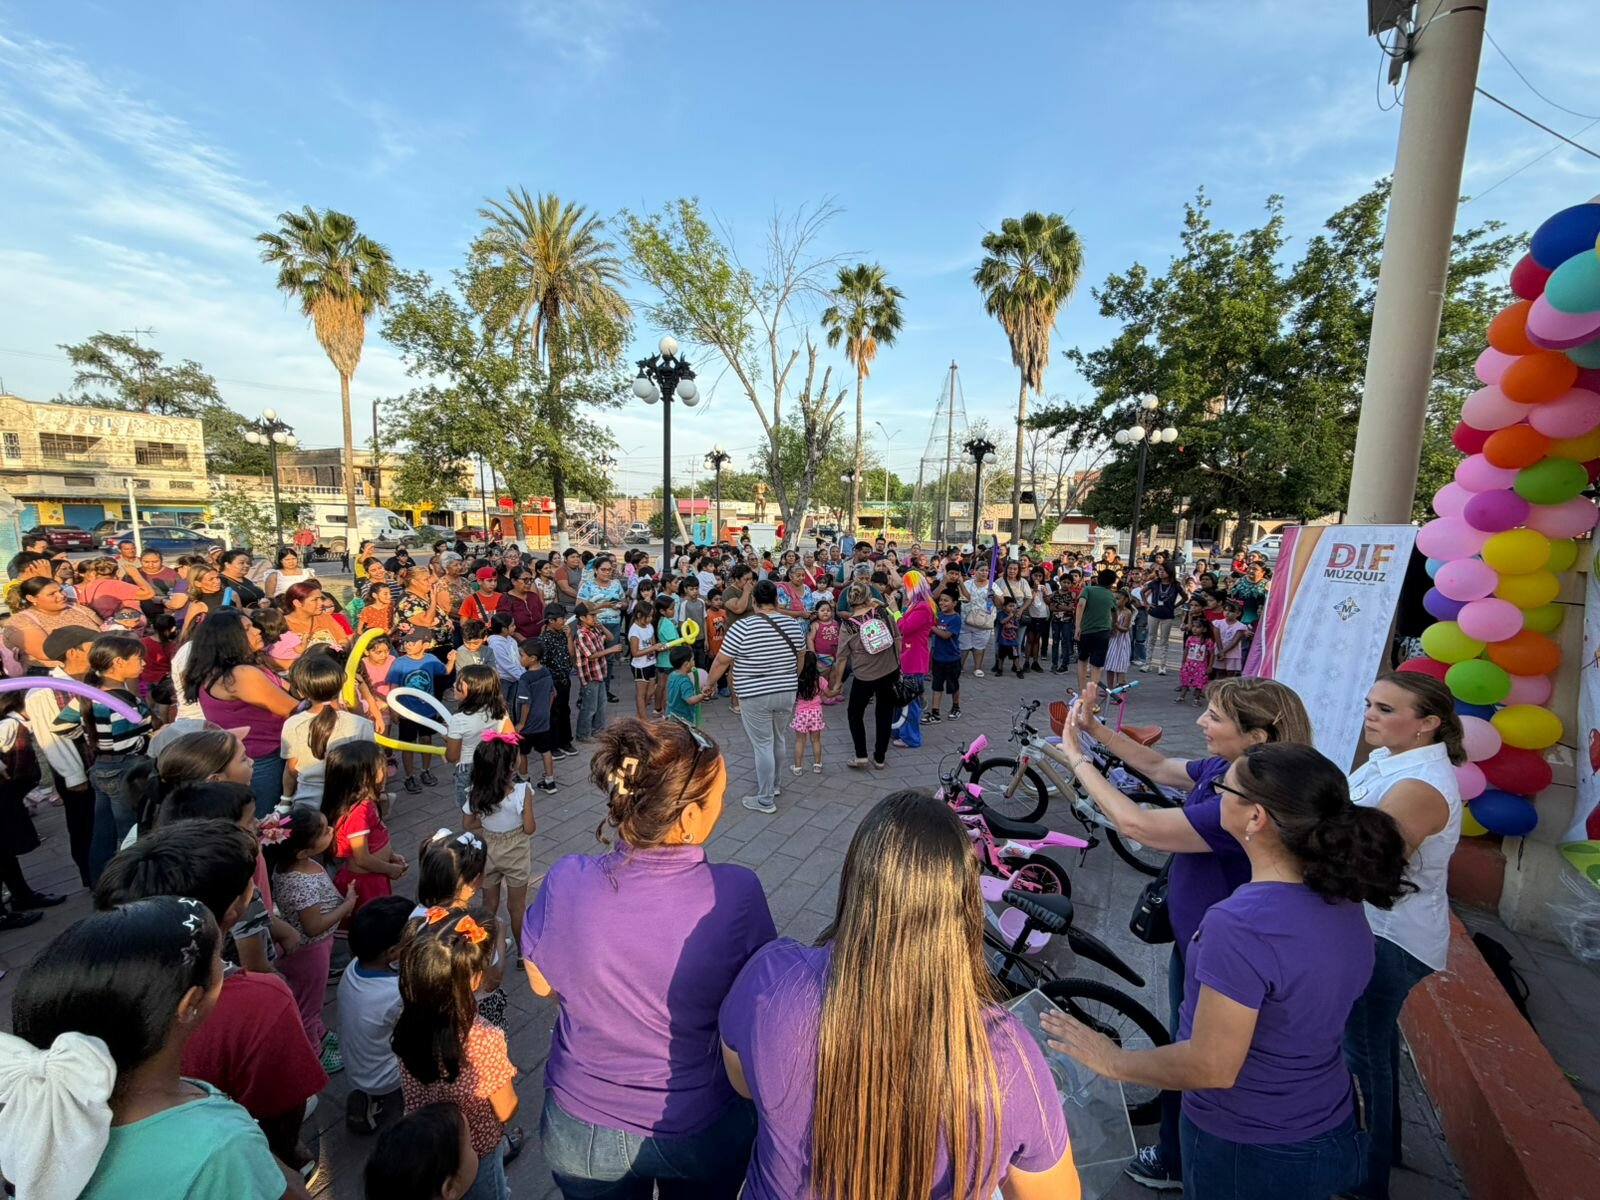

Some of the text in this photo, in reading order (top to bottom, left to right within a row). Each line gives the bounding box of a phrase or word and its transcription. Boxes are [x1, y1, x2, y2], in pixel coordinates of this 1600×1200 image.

[1327, 543, 1395, 570] DIF
[1324, 568, 1386, 582] MÚZQUIZ
[1007, 892, 1066, 930] CONDOR
